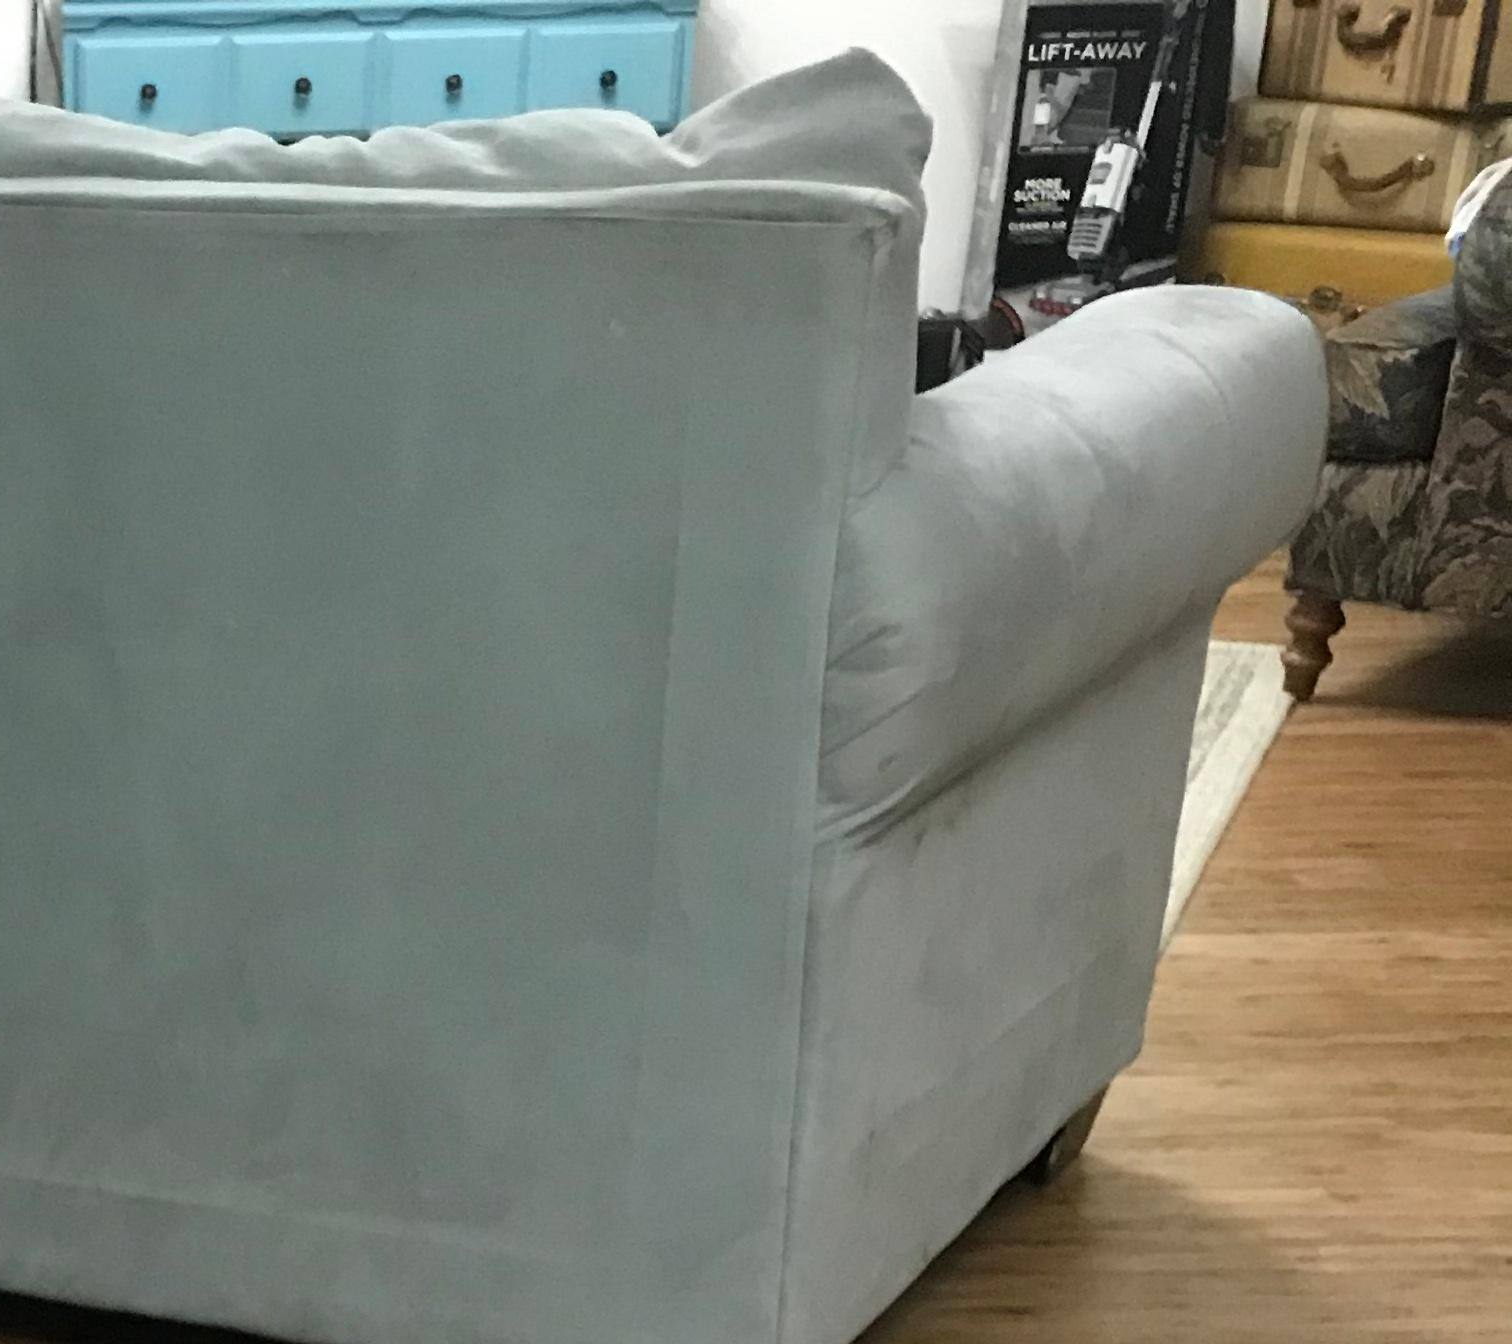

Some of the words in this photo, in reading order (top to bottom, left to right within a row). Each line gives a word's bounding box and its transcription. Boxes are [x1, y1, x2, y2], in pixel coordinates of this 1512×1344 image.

[1028, 41, 1147, 62] LIFT-AWAY
[1025, 177, 1062, 190] MORE
[1014, 188, 1071, 203] SUCTION
